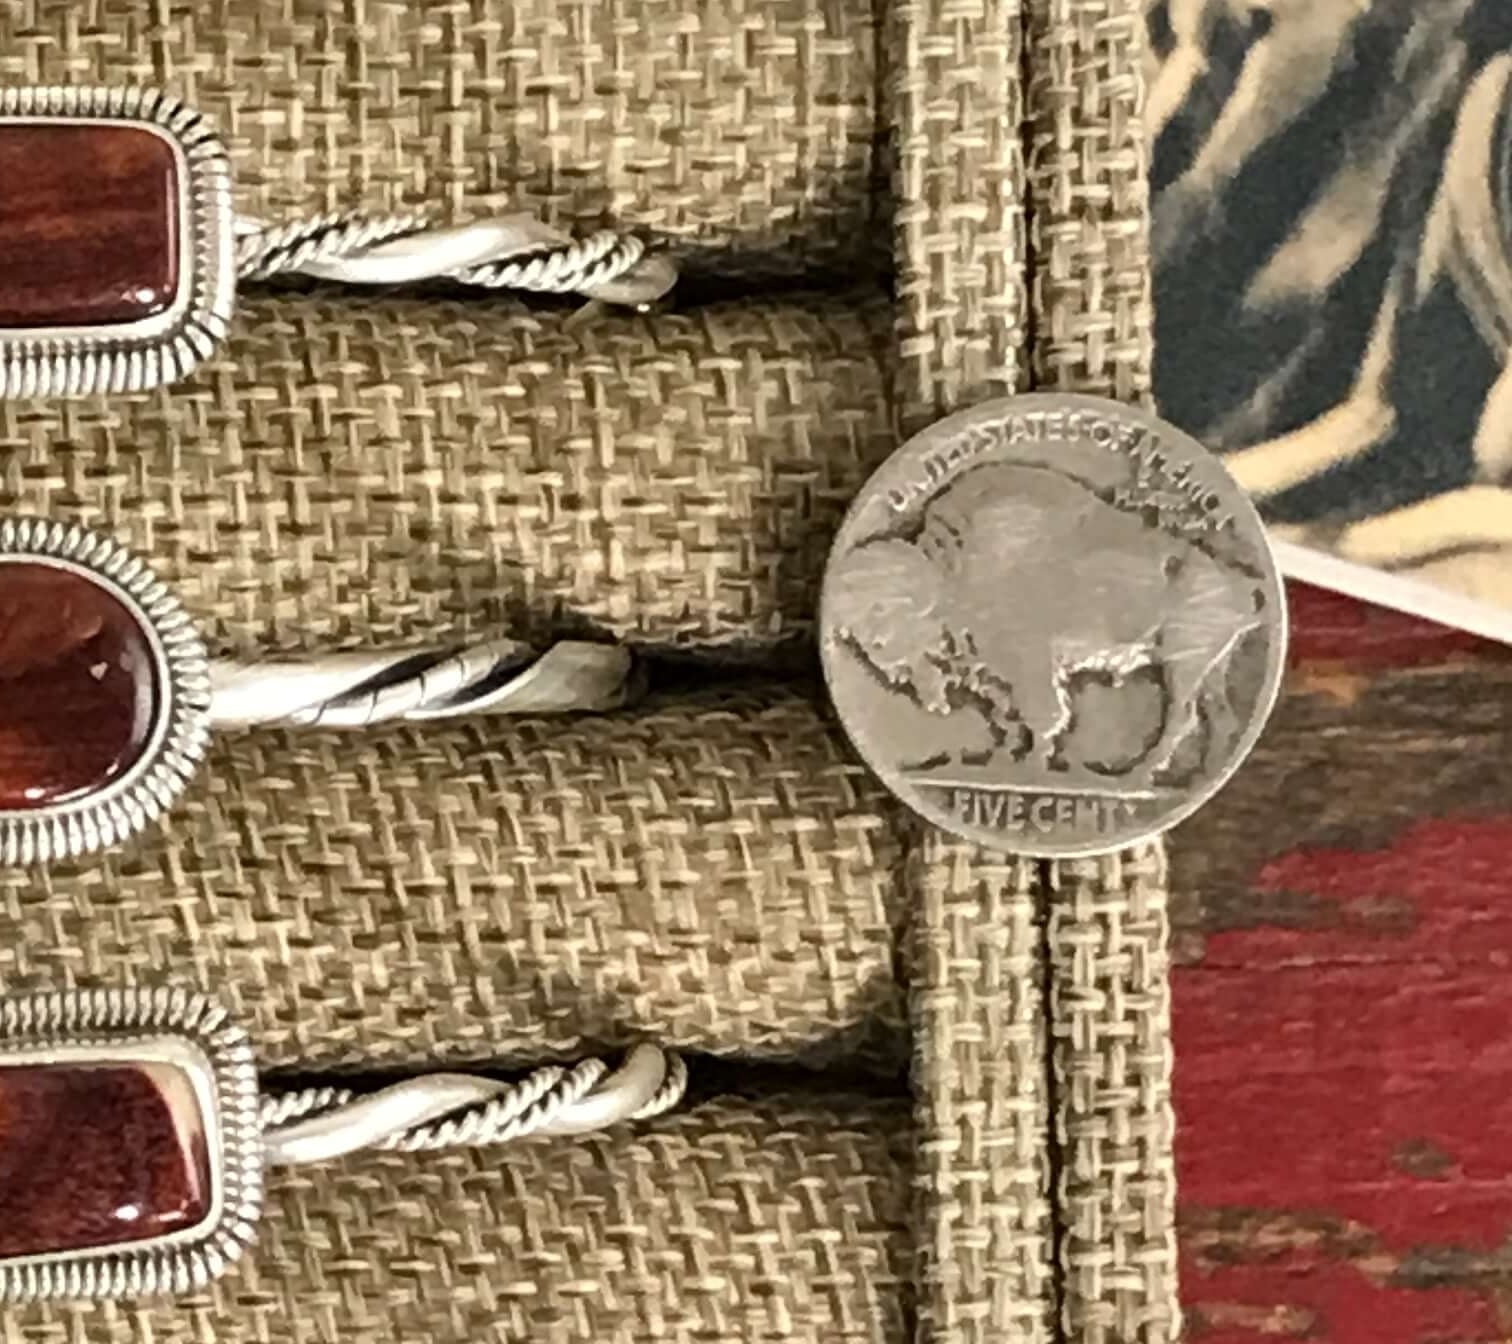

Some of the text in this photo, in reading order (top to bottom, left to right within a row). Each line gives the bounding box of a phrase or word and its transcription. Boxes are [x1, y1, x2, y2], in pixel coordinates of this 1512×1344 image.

[980, 409, 1082, 447] STATES
[1089, 420, 1130, 452] OF
[954, 789, 1026, 831] FIVE
